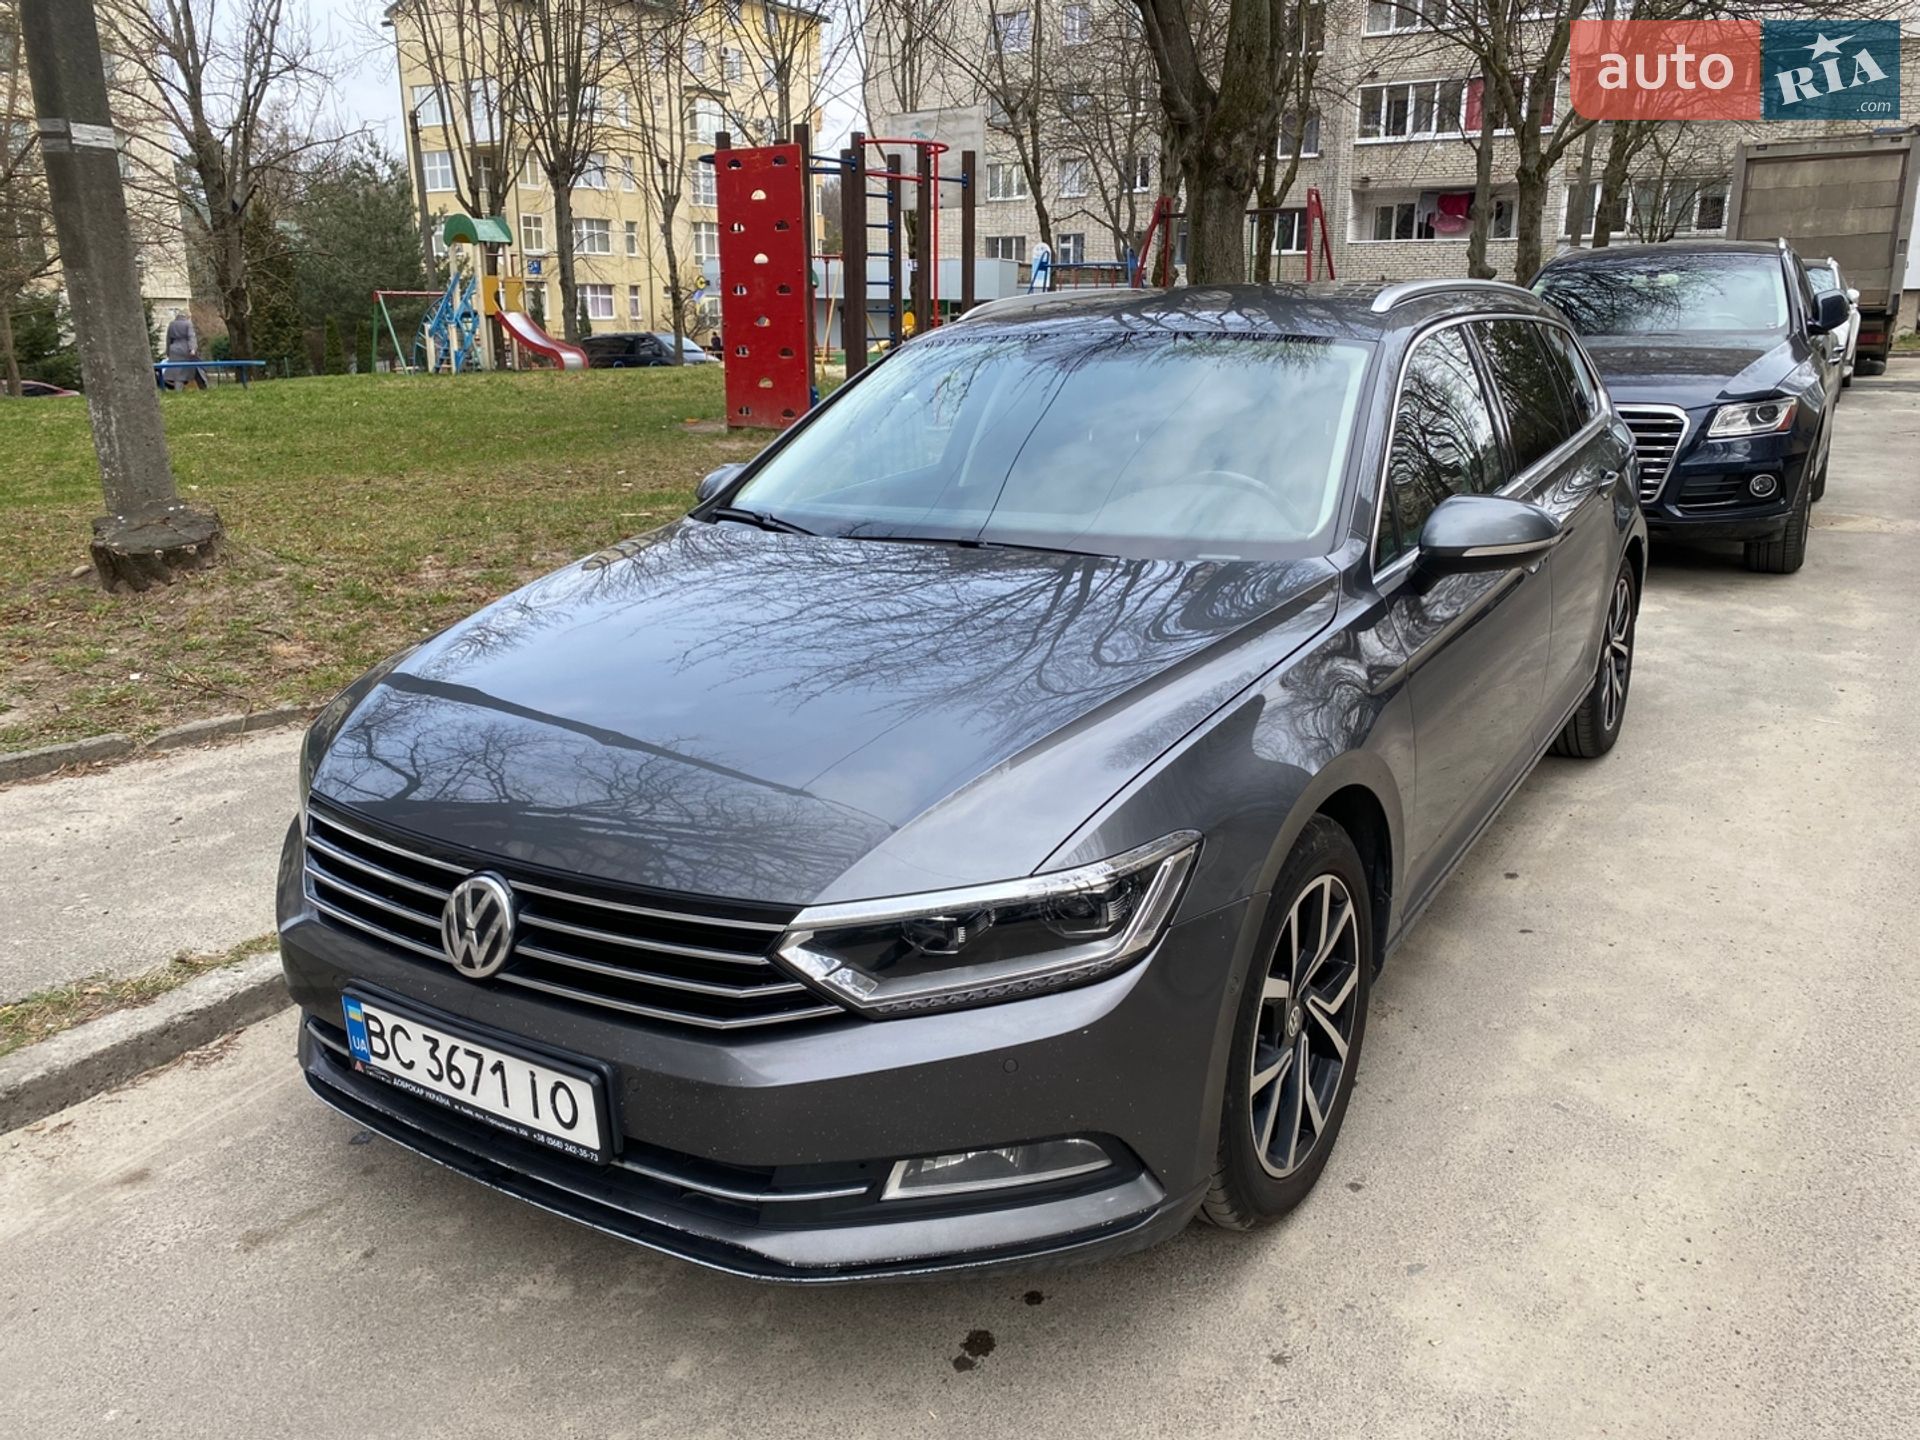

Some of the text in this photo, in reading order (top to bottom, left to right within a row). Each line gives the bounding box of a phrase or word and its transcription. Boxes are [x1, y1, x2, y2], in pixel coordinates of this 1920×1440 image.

[352, 1035, 368, 1054] UA
[363, 1011, 416, 1071] BC
[422, 1033, 509, 1109] 3671
[529, 1069, 579, 1131] IO
